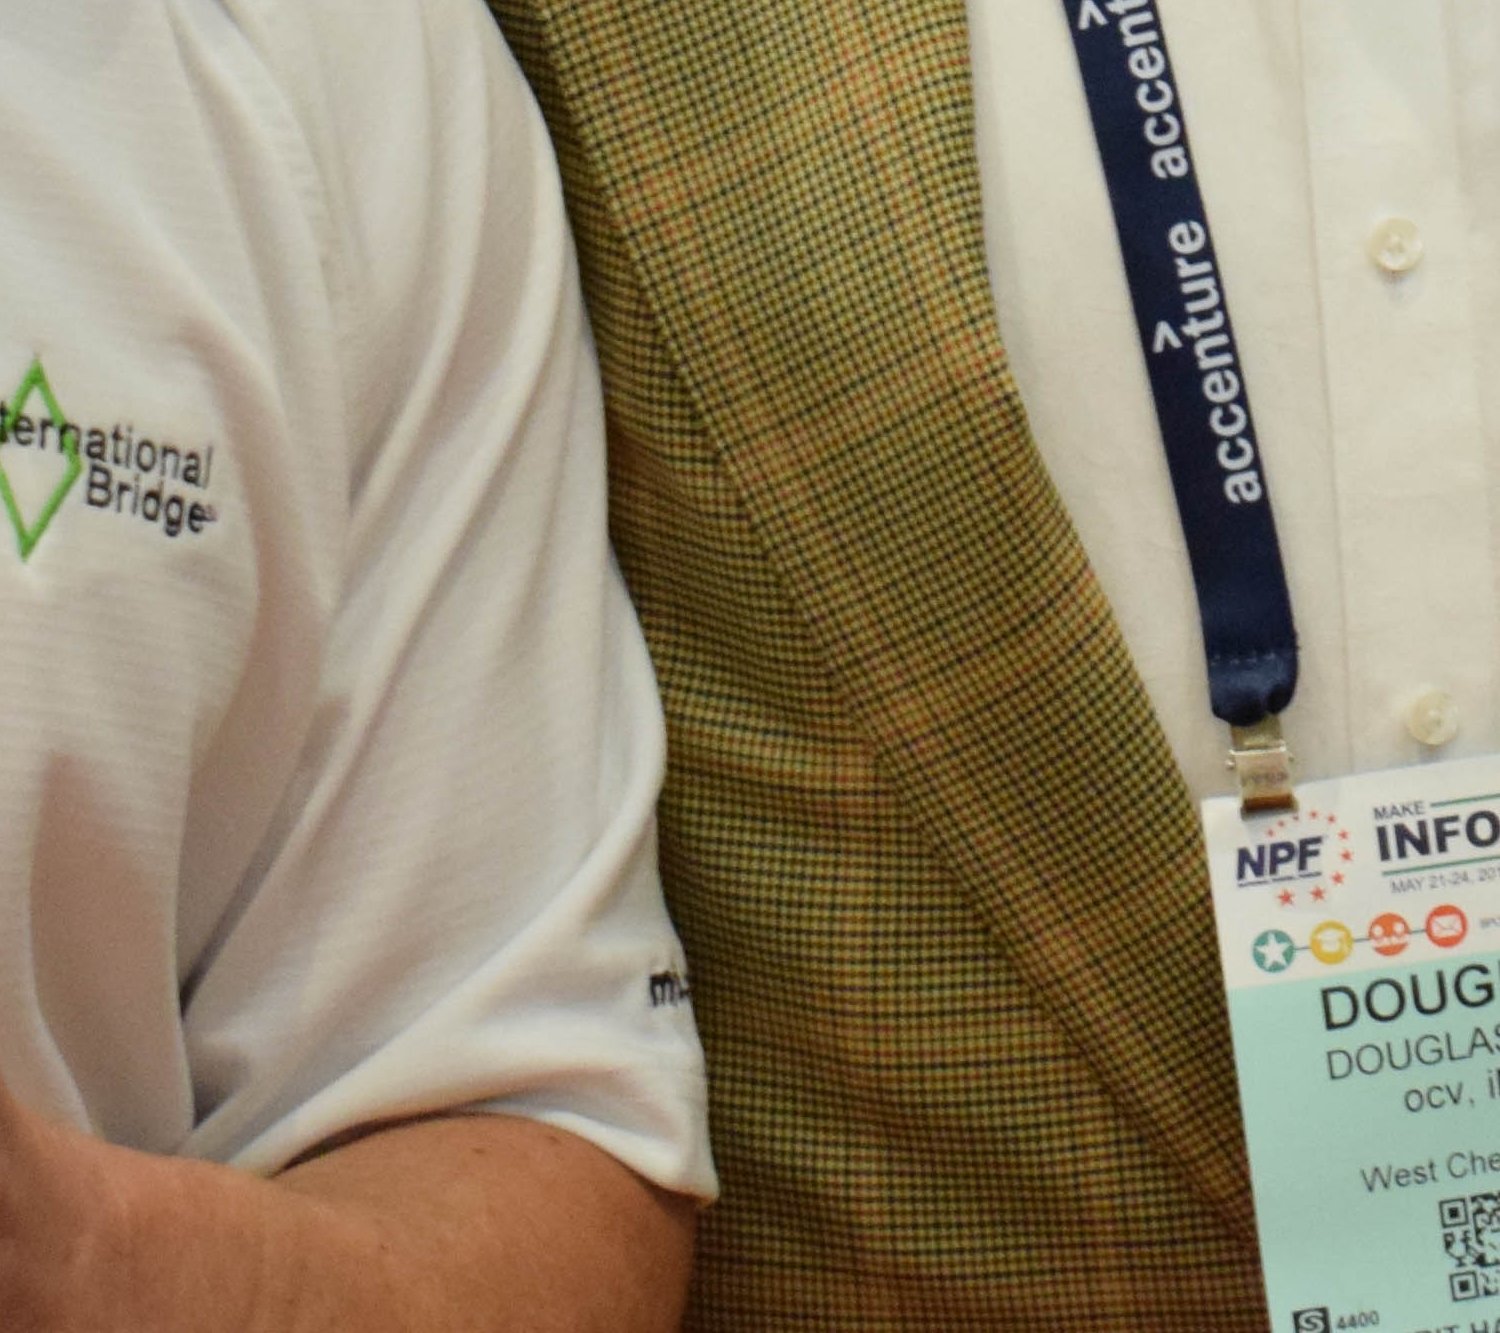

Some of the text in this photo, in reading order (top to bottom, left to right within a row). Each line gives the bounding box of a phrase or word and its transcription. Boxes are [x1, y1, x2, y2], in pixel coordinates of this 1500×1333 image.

[1168, 220, 1265, 506] accenture
[86, 463, 208, 538] Bridge
[1373, 801, 1426, 820] MAKE
[1237, 835, 1323, 880] NPF
[1360, 1158, 1439, 1193] West
[1336, 1311, 1380, 1332] 4400
